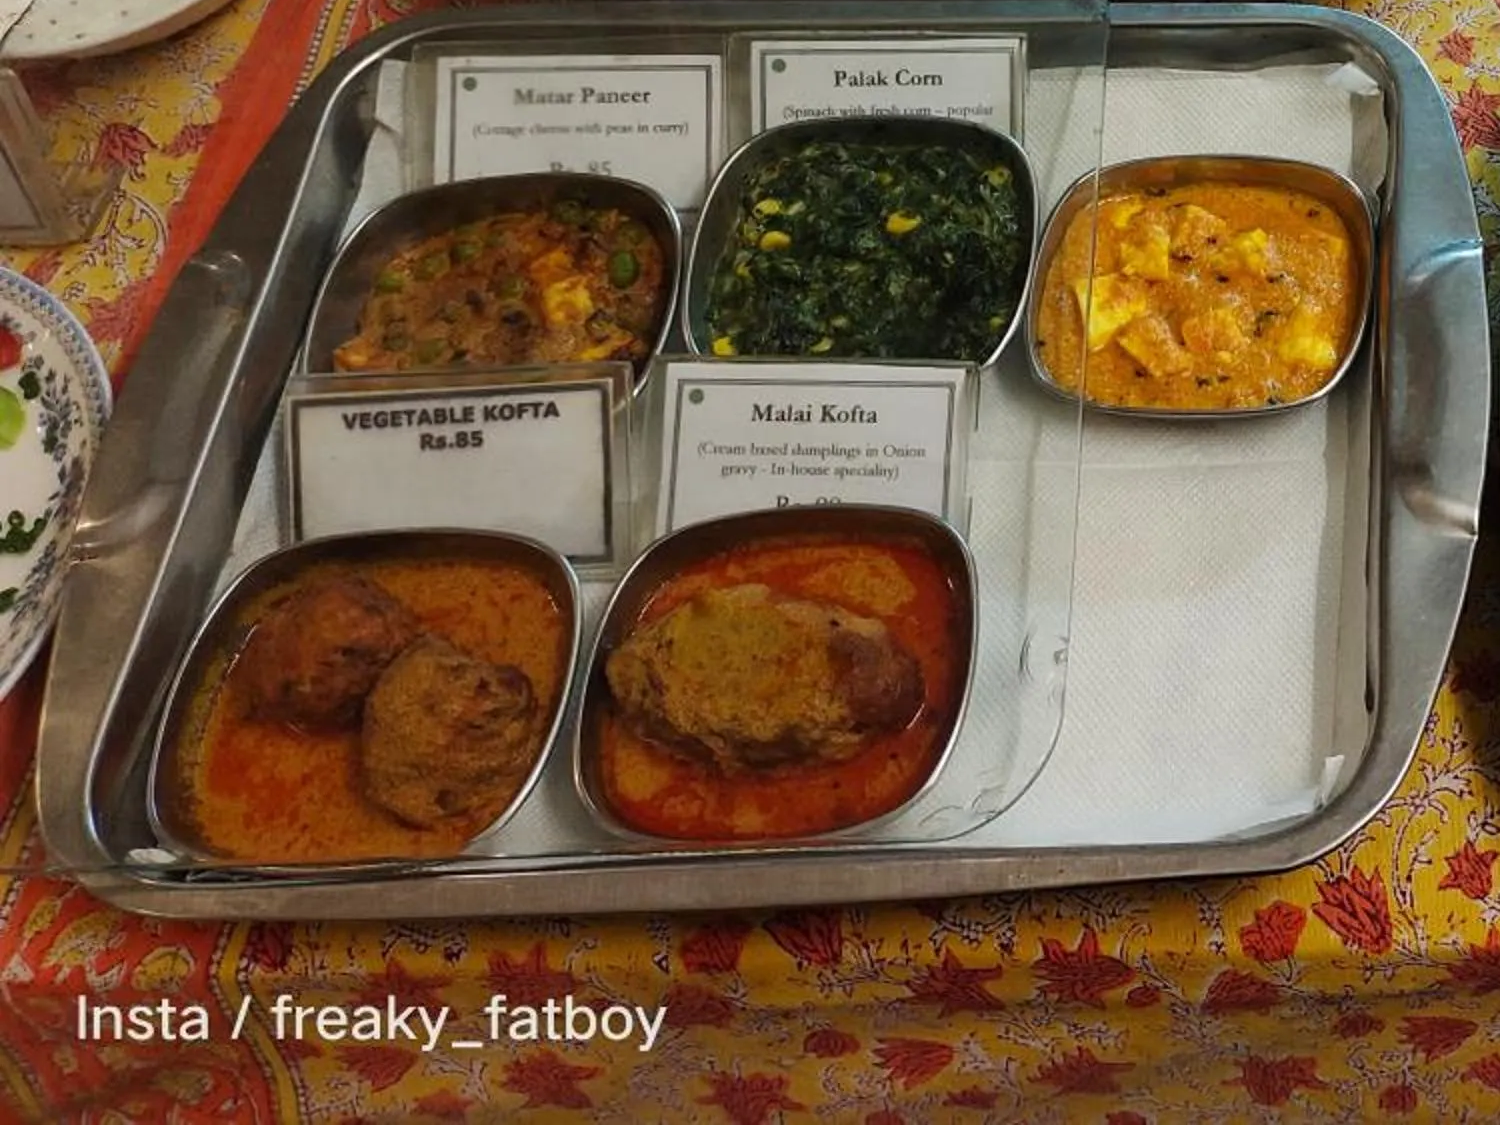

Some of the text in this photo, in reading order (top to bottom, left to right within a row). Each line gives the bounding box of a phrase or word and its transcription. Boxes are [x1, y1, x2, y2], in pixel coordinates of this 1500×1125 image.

[833, 69, 944, 88] Palak Corn
[513, 86, 652, 106] Matar Paneer
[783, 105, 837, 120] (Spinach
[839, 104, 866, 117] with
[946, 104, 994, 119] popular
[606, 124, 634, 136] peas
[637, 121, 649, 134] in
[652, 122, 690, 136] curry)
[342, 401, 560, 430] VEGETABLE KOFTA
[750, 403, 878, 425] Malai Kofta
[420, 430, 485, 452] Rs.85
[697, 443, 926, 461] (Cream based dumplings in Onion
[721, 464, 757, 478] gravy
[771, 463, 830, 476] In-house
